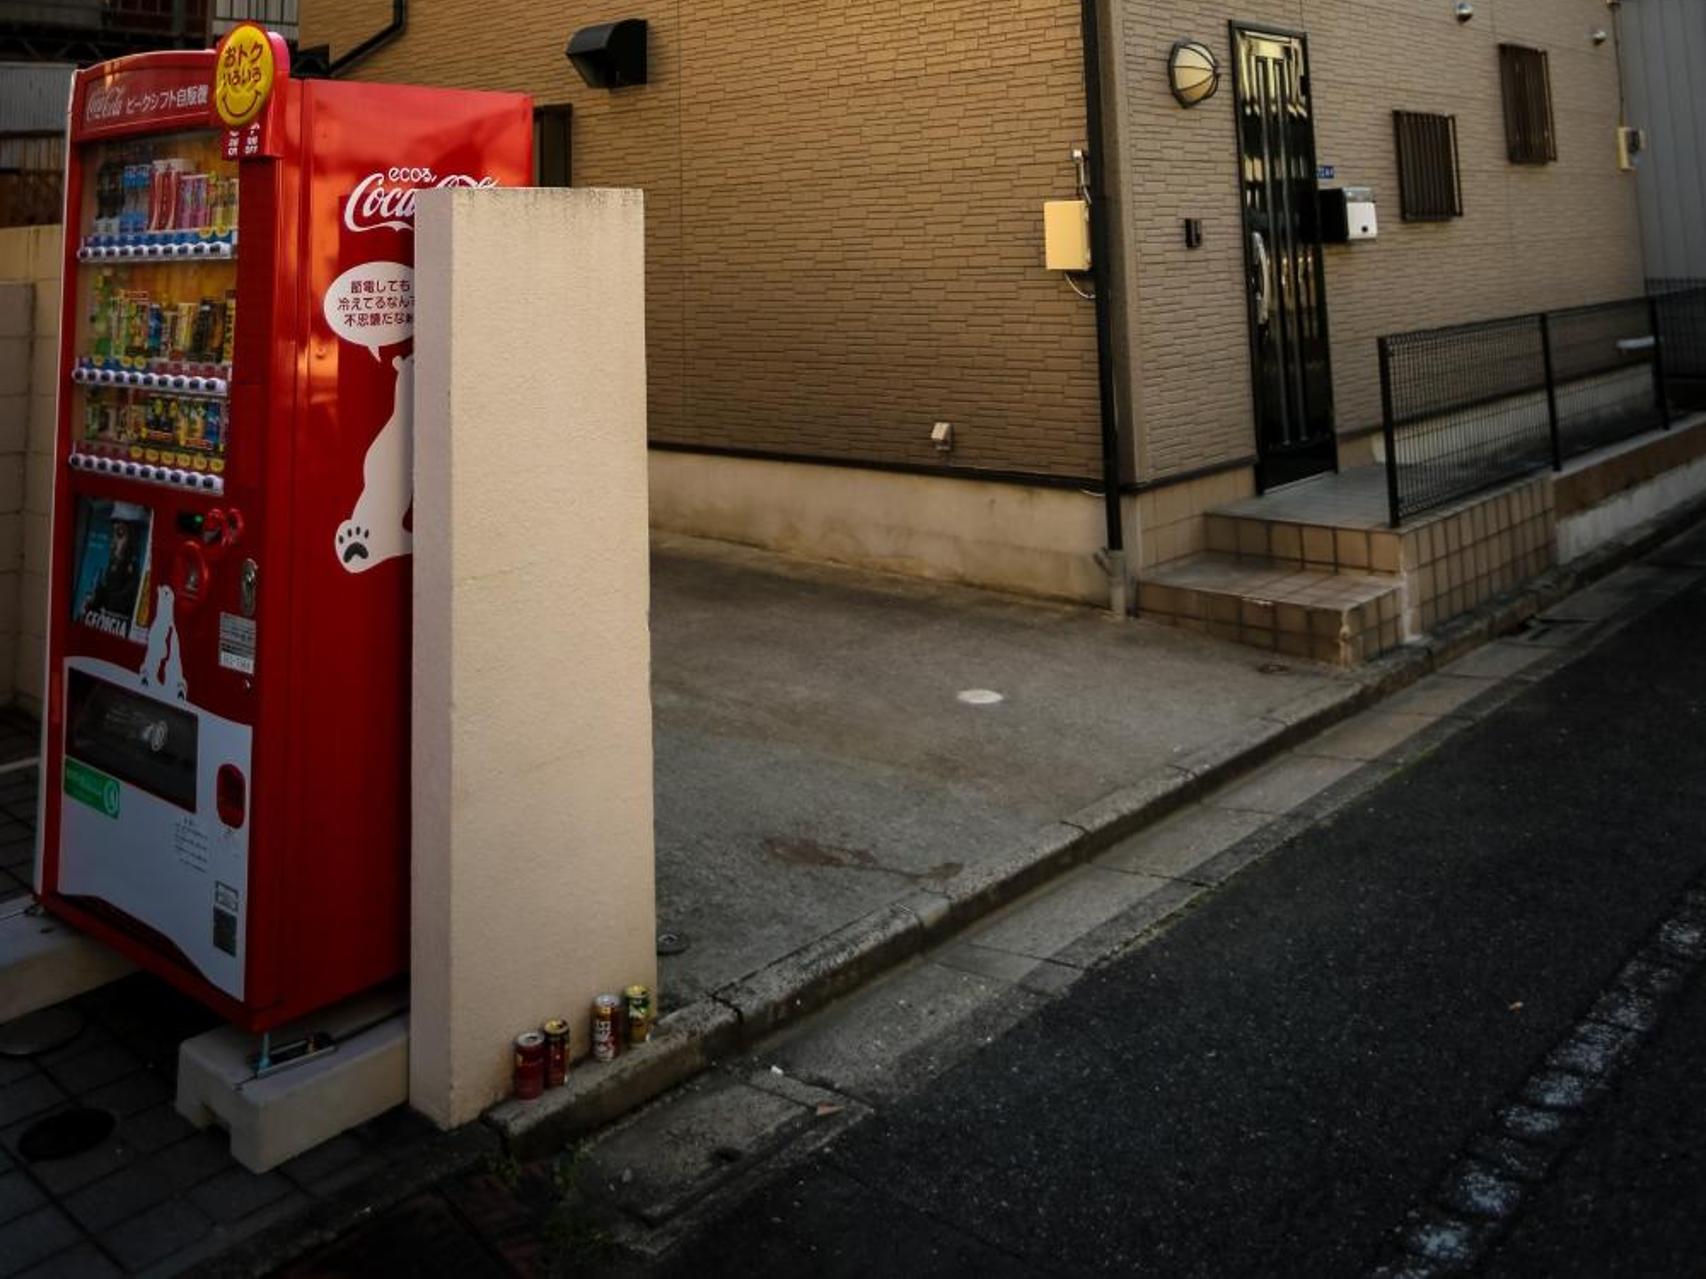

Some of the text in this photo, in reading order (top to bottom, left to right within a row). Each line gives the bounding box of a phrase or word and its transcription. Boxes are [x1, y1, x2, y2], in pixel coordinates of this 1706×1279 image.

[224, 41, 264, 68] おトク
[223, 67, 262, 87] いろいろ
[351, 280, 410, 294] 節電しても
